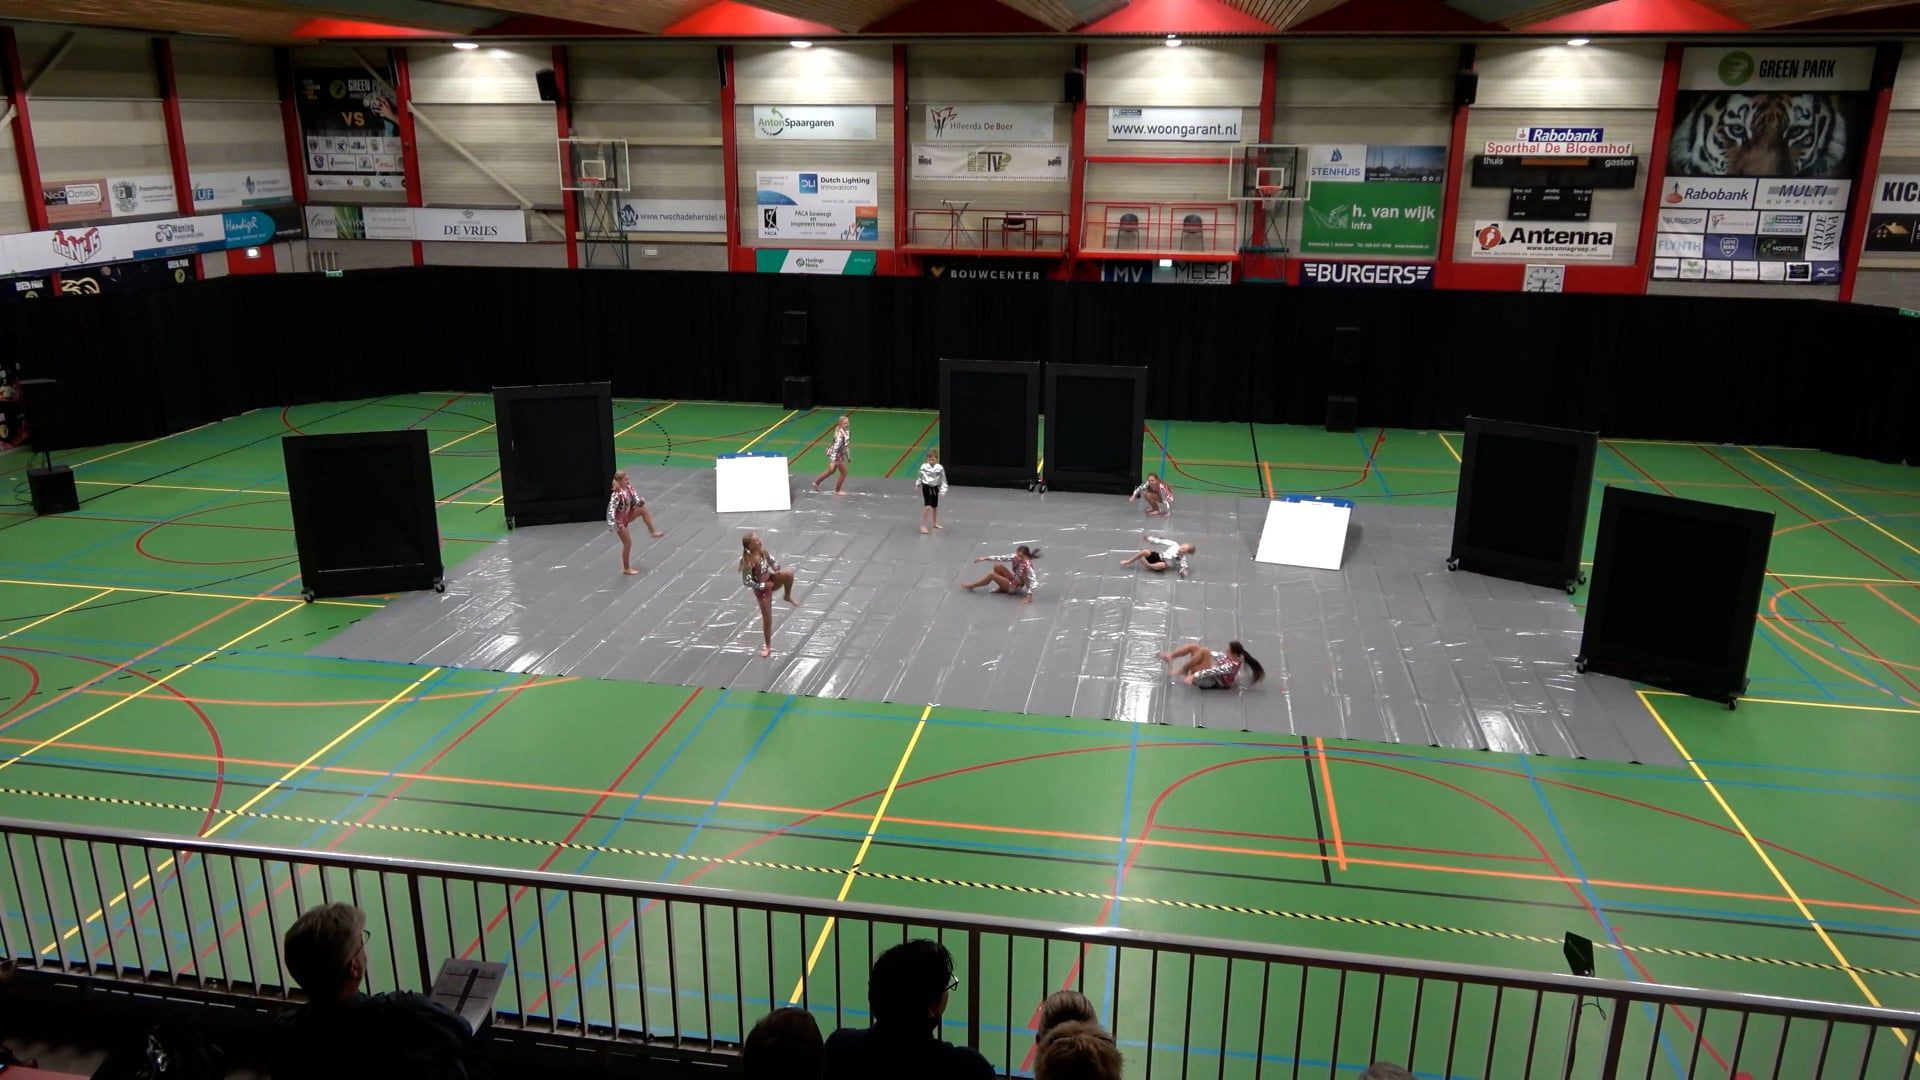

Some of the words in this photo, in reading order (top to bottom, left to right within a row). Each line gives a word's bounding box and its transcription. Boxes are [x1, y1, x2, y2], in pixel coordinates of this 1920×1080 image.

[1759, 59, 1799, 78] GREEN
[1802, 60, 1836, 78] PARK
[341, 111, 365, 126] VS
[950, 122, 982, 130] Hilverda
[984, 122, 994, 130] De
[996, 122, 1013, 130] Boer
[1112, 123, 1237, 137] www.woongarant.nl
[1533, 129, 1598, 142] Rabobank
[1487, 142, 1540, 155] Sporthal
[1545, 143, 1561, 153] De
[1566, 143, 1631, 154] Bloemhof
[1483, 157, 1503, 165] thuis
[1605, 159, 1634, 168] gasten
[842, 177, 870, 185] Lighting
[1684, 188, 1749, 201] Rabobank
[1778, 184, 1828, 197] MULTI
[1352, 204, 1366, 217] h.
[1372, 207, 1399, 218] van
[1405, 206, 1436, 222] wijk
[1665, 217, 1701, 225] BURGERS
[444, 225, 460, 236] DE
[465, 225, 498, 236] VRIES
[1509, 227, 1613, 245] Antenna
[1657, 239, 1700, 252] FLYNTH
[950, 270, 1039, 280] BOUWCENTER
[1113, 267, 1142, 282] MV
[1175, 263, 1229, 279] MEER
[1317, 264, 1417, 284] BURGERS
